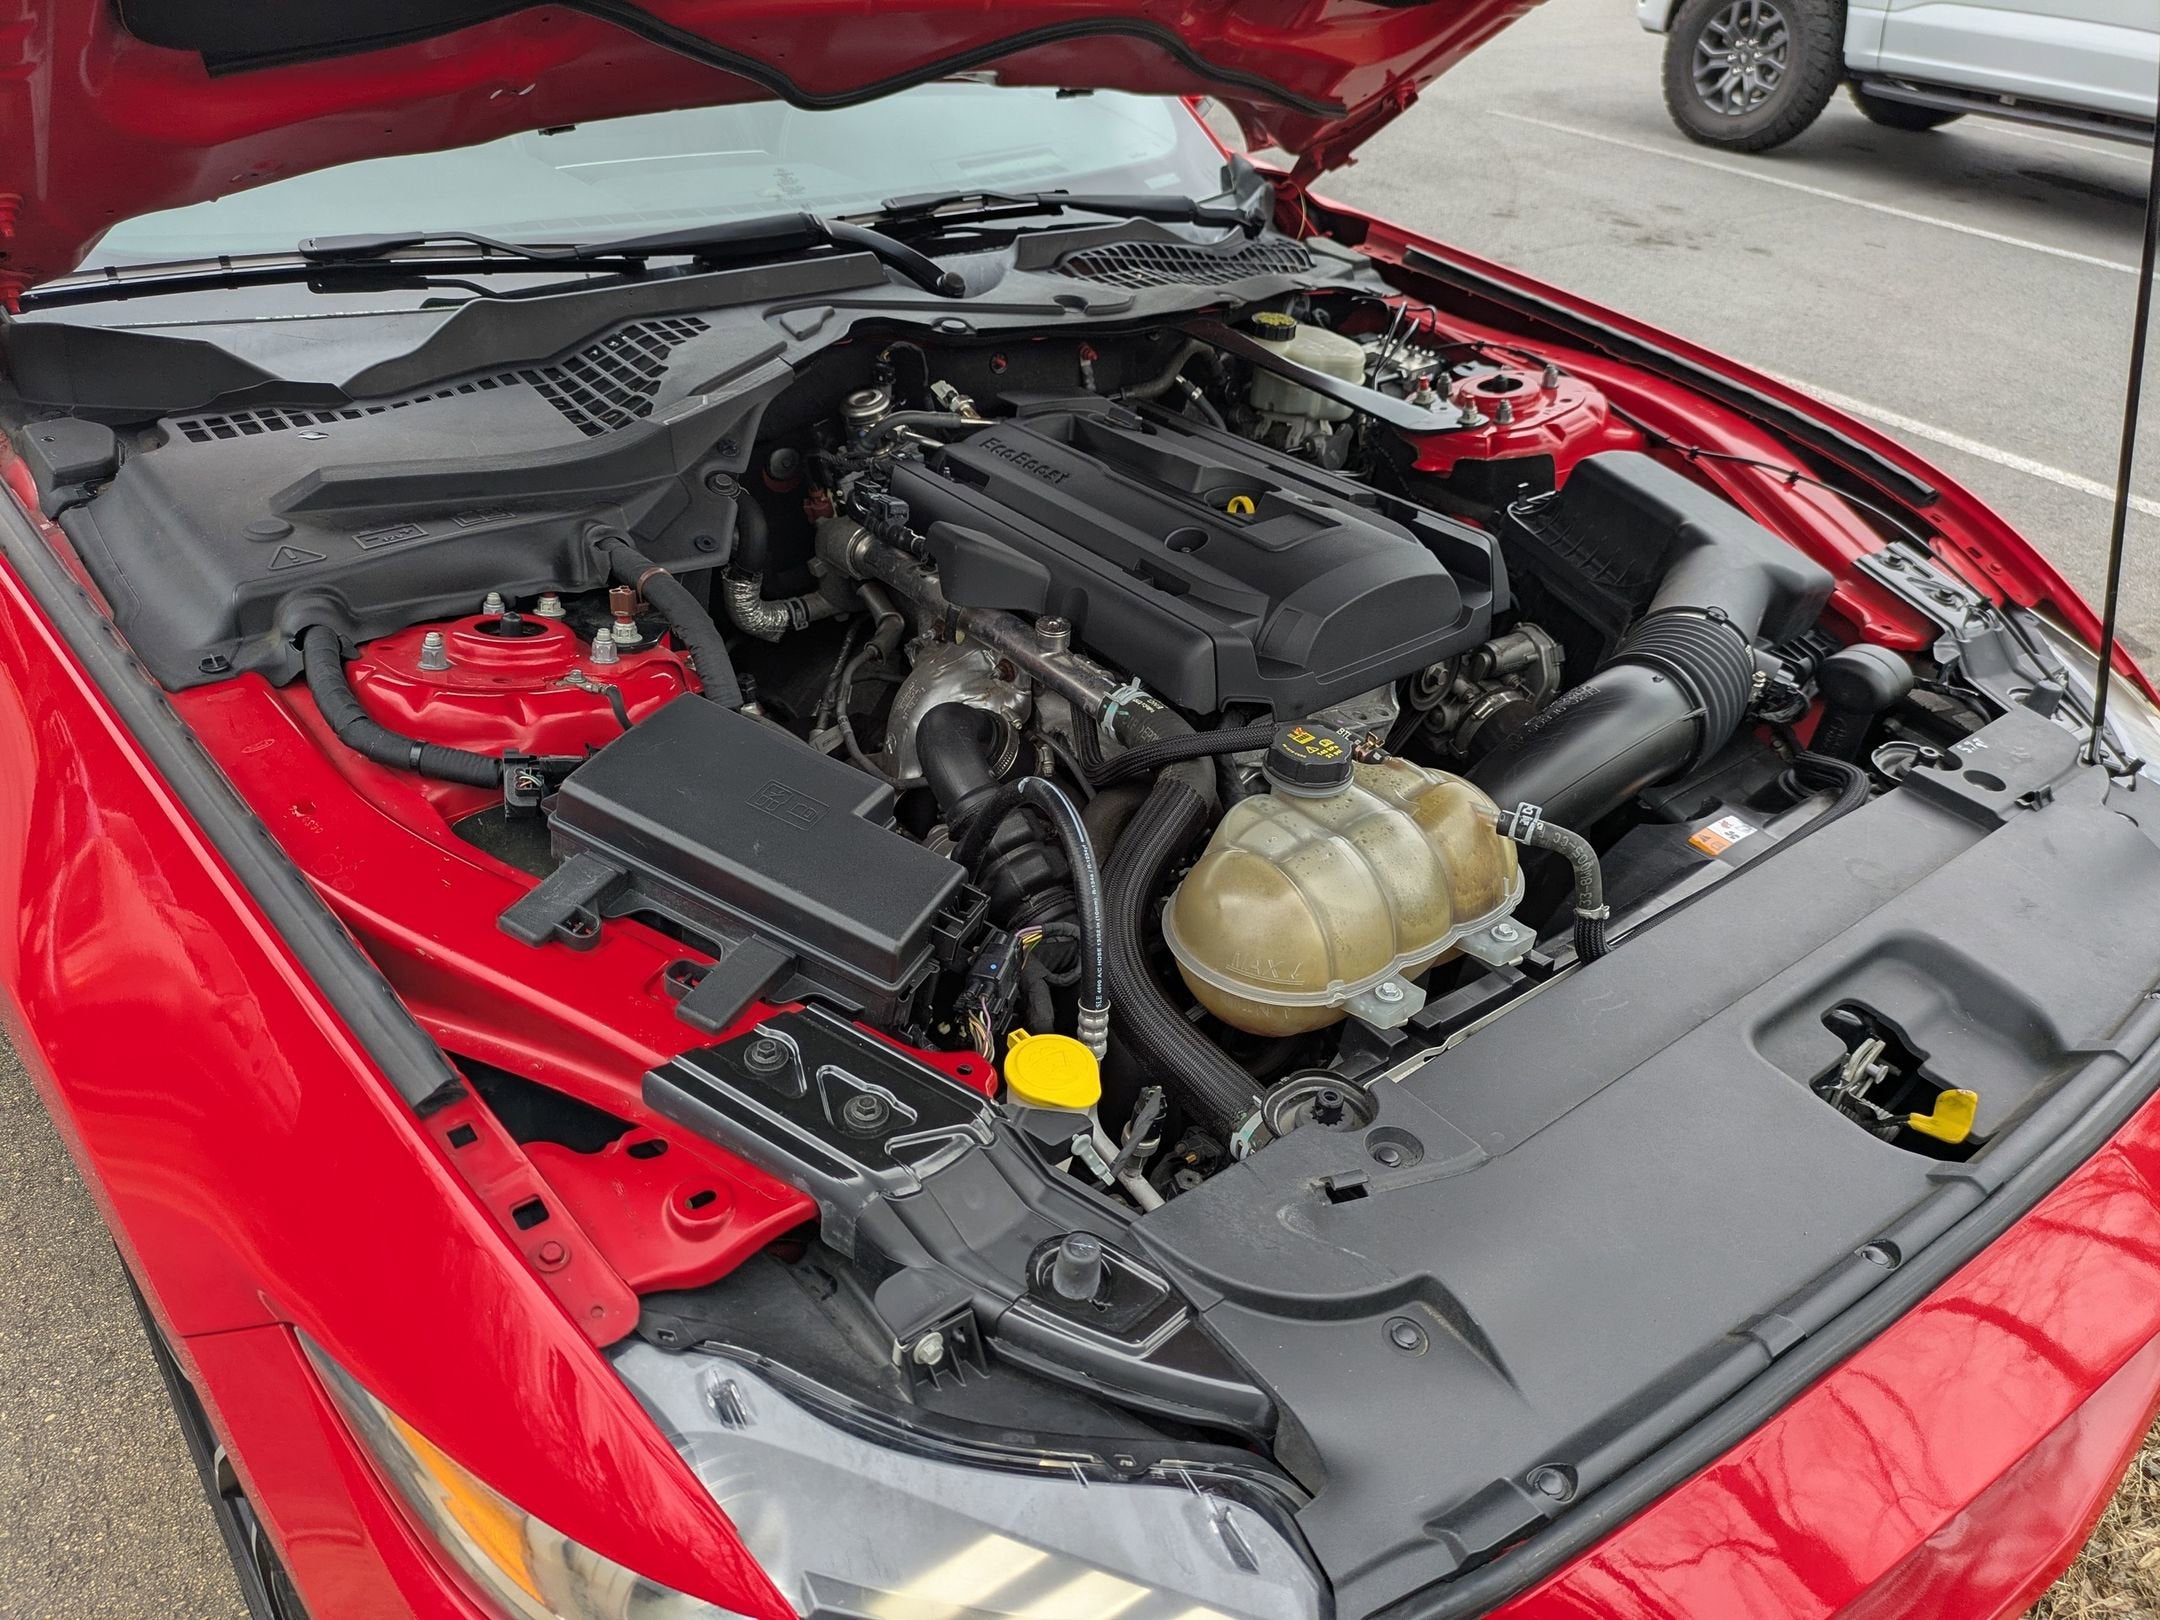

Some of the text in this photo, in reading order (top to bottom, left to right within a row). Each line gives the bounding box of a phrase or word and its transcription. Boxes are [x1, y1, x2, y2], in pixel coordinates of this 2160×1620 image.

[978, 436, 1070, 484] EcoBoost
[1082, 844, 1092, 869] R-1234yf
[1089, 873, 1097, 895] R-134a
